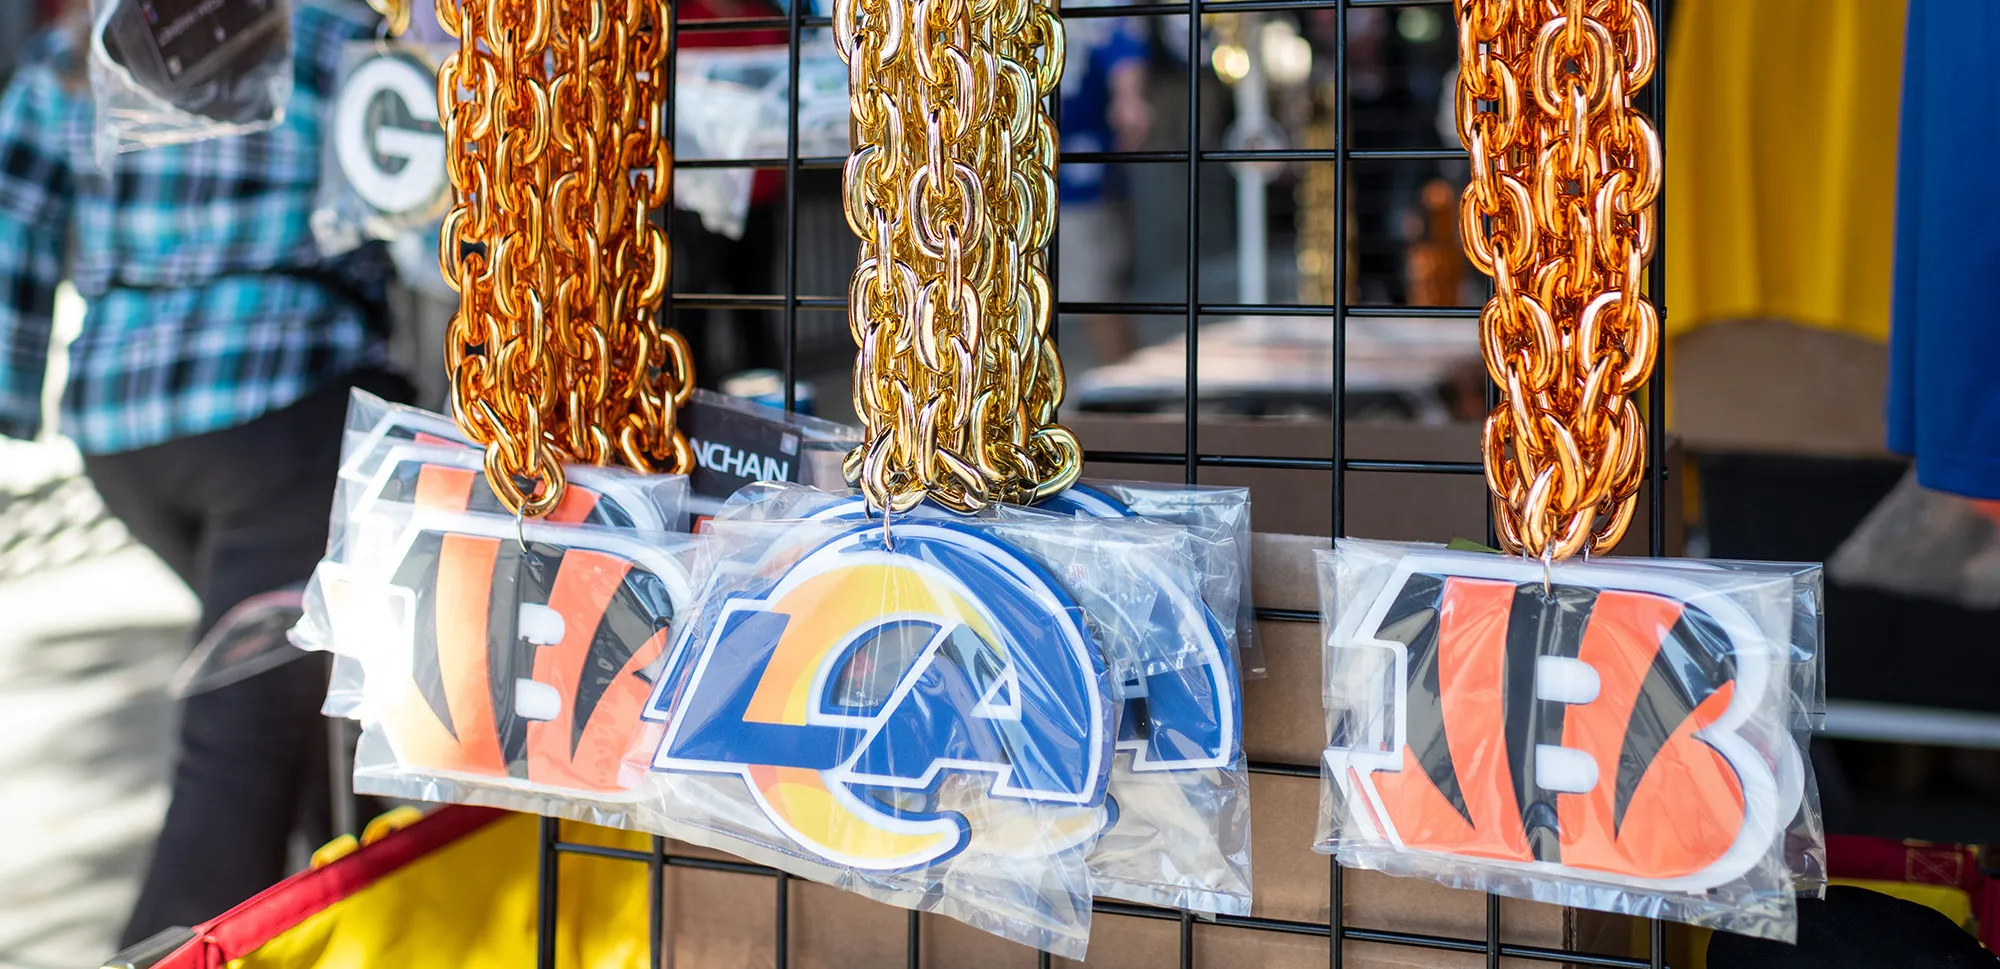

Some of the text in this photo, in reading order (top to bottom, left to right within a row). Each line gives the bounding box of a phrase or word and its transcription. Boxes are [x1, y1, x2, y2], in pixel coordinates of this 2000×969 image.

[336, 56, 447, 213] G
[689, 436, 789, 483] NCHAIN
[652, 520, 1114, 810] LA
[1345, 556, 1778, 892] B
